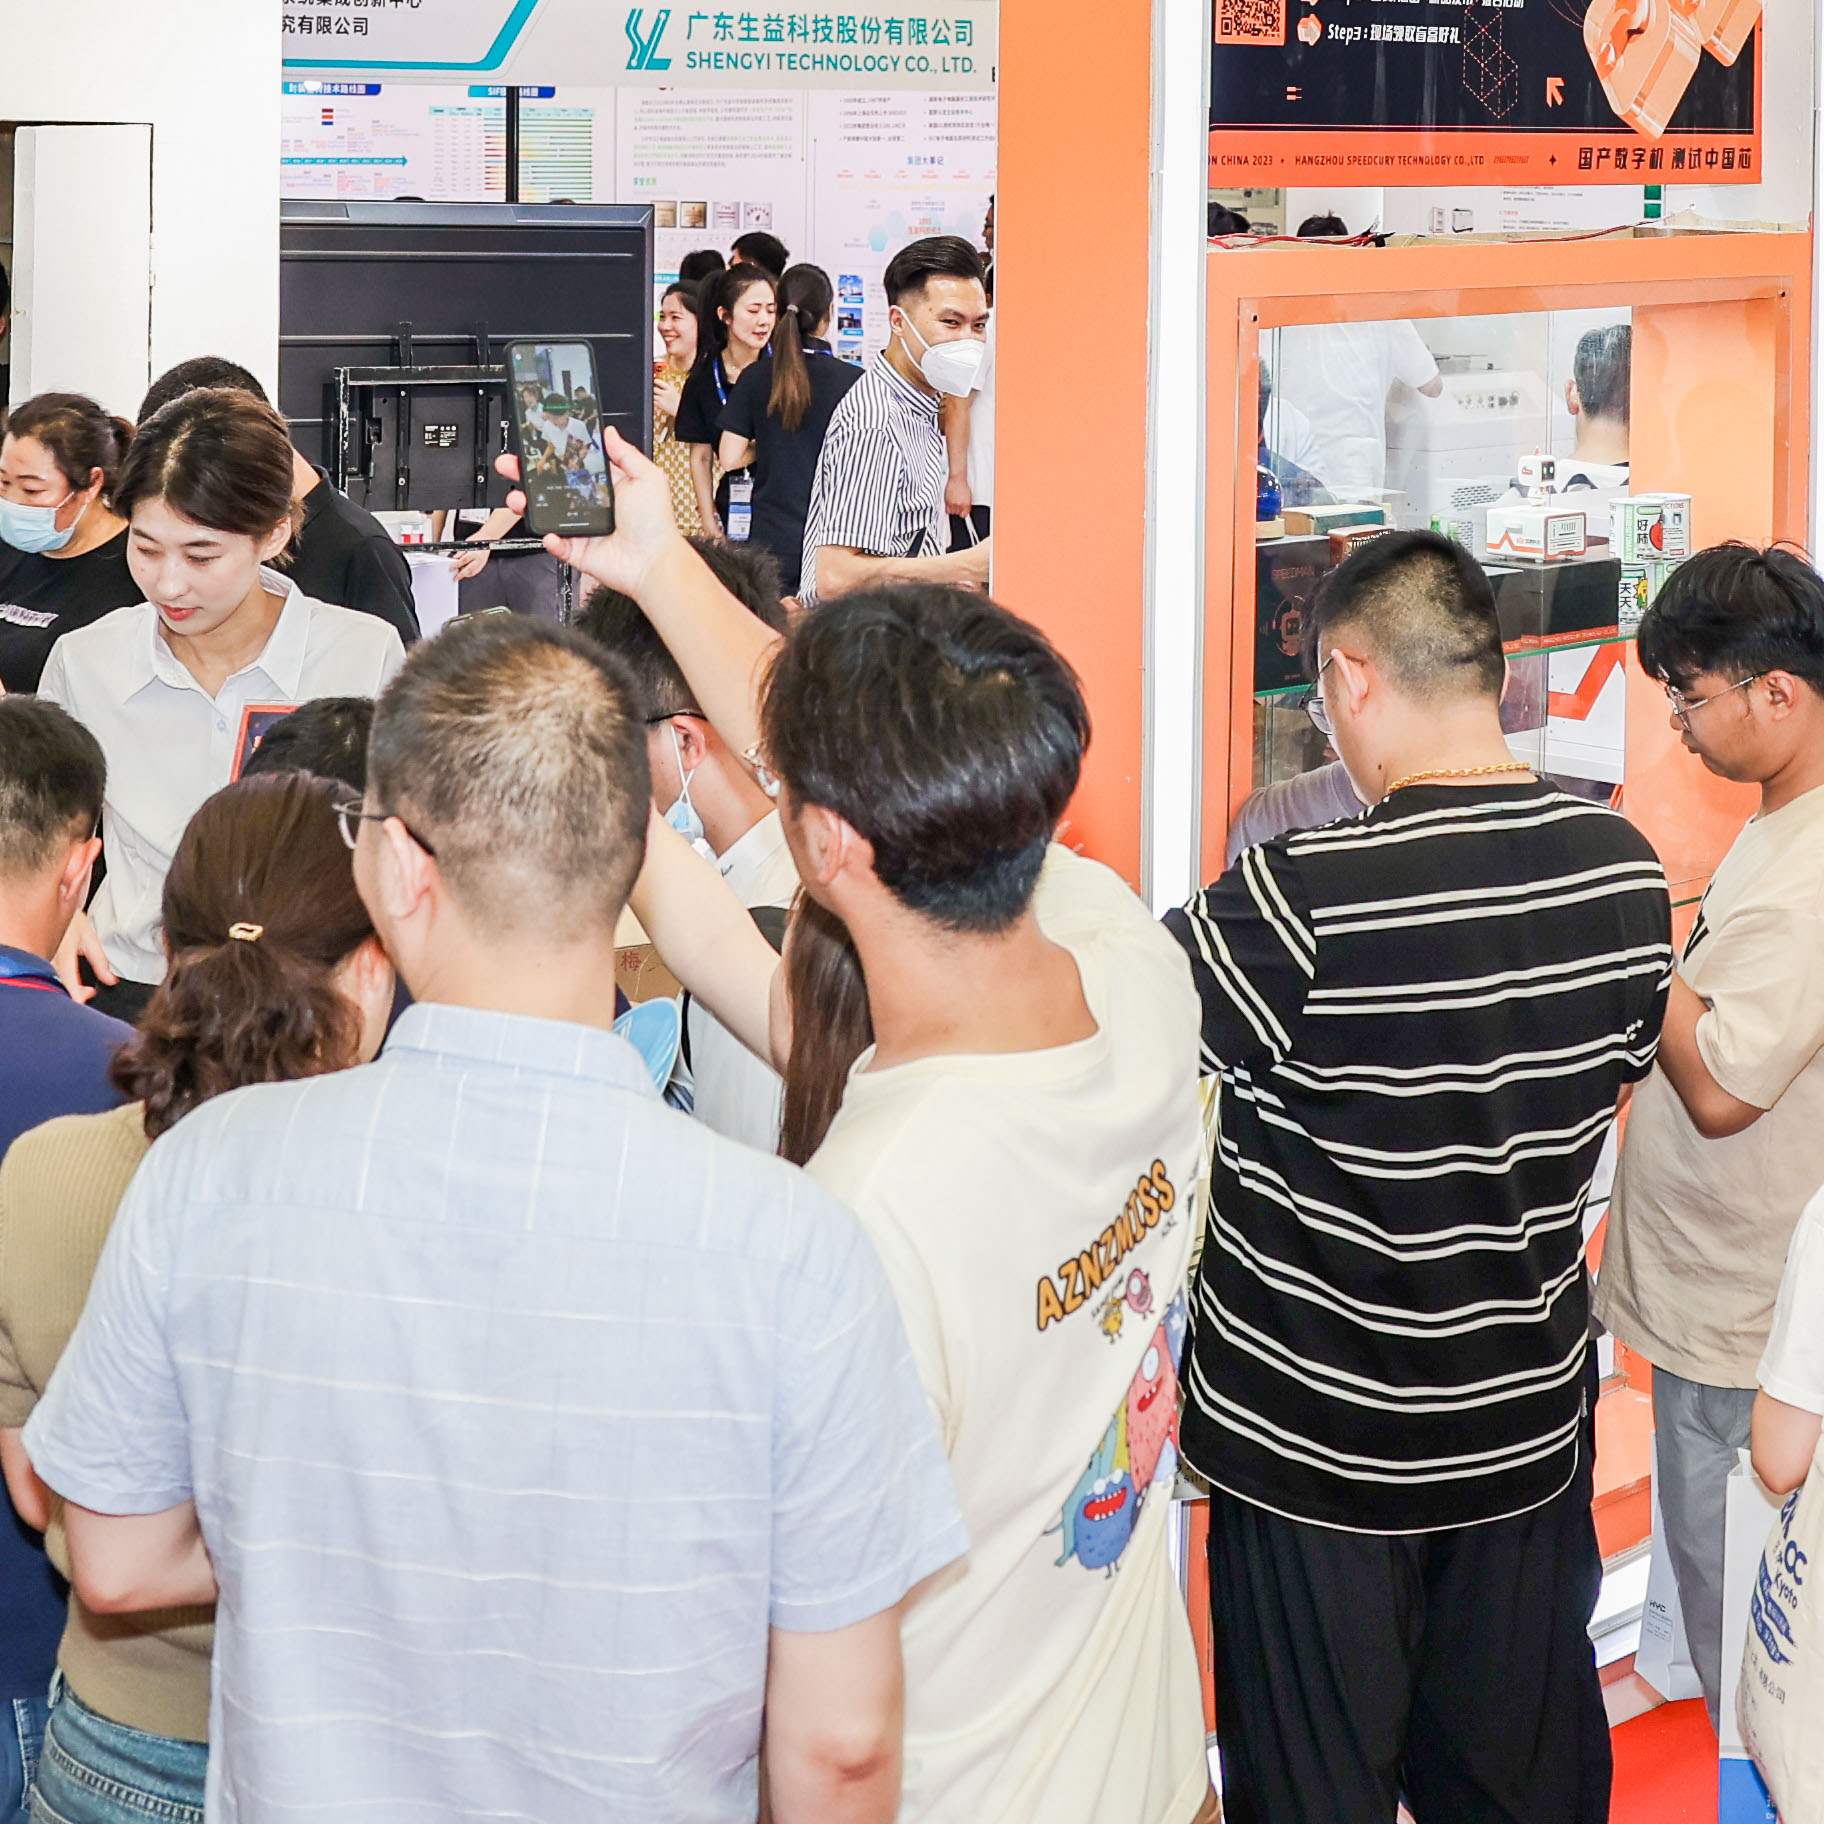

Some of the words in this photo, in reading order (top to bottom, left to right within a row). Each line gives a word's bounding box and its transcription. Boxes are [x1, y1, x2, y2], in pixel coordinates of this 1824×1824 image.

[686, 12, 974, 48] 广东生益科技股份有限公司
[686, 51, 772, 71] SHENGYI
[775, 52, 902, 73] TECHNOLOGY
[1221, 155, 1250, 166] CHINA
[1252, 155, 1273, 166] 2023
[1295, 155, 1345, 166] HANGZHOU
[1347, 155, 1395, 166] SPEEDCURY
[1398, 155, 1451, 166] TECHNOLOGY
[1578, 147, 1664, 170] 国产数字机
[1671, 147, 1753, 170] 测试中国芯
[1619, 582, 1632, 609] 天天
[1036, 1158, 1175, 1332] AZNZMISS
